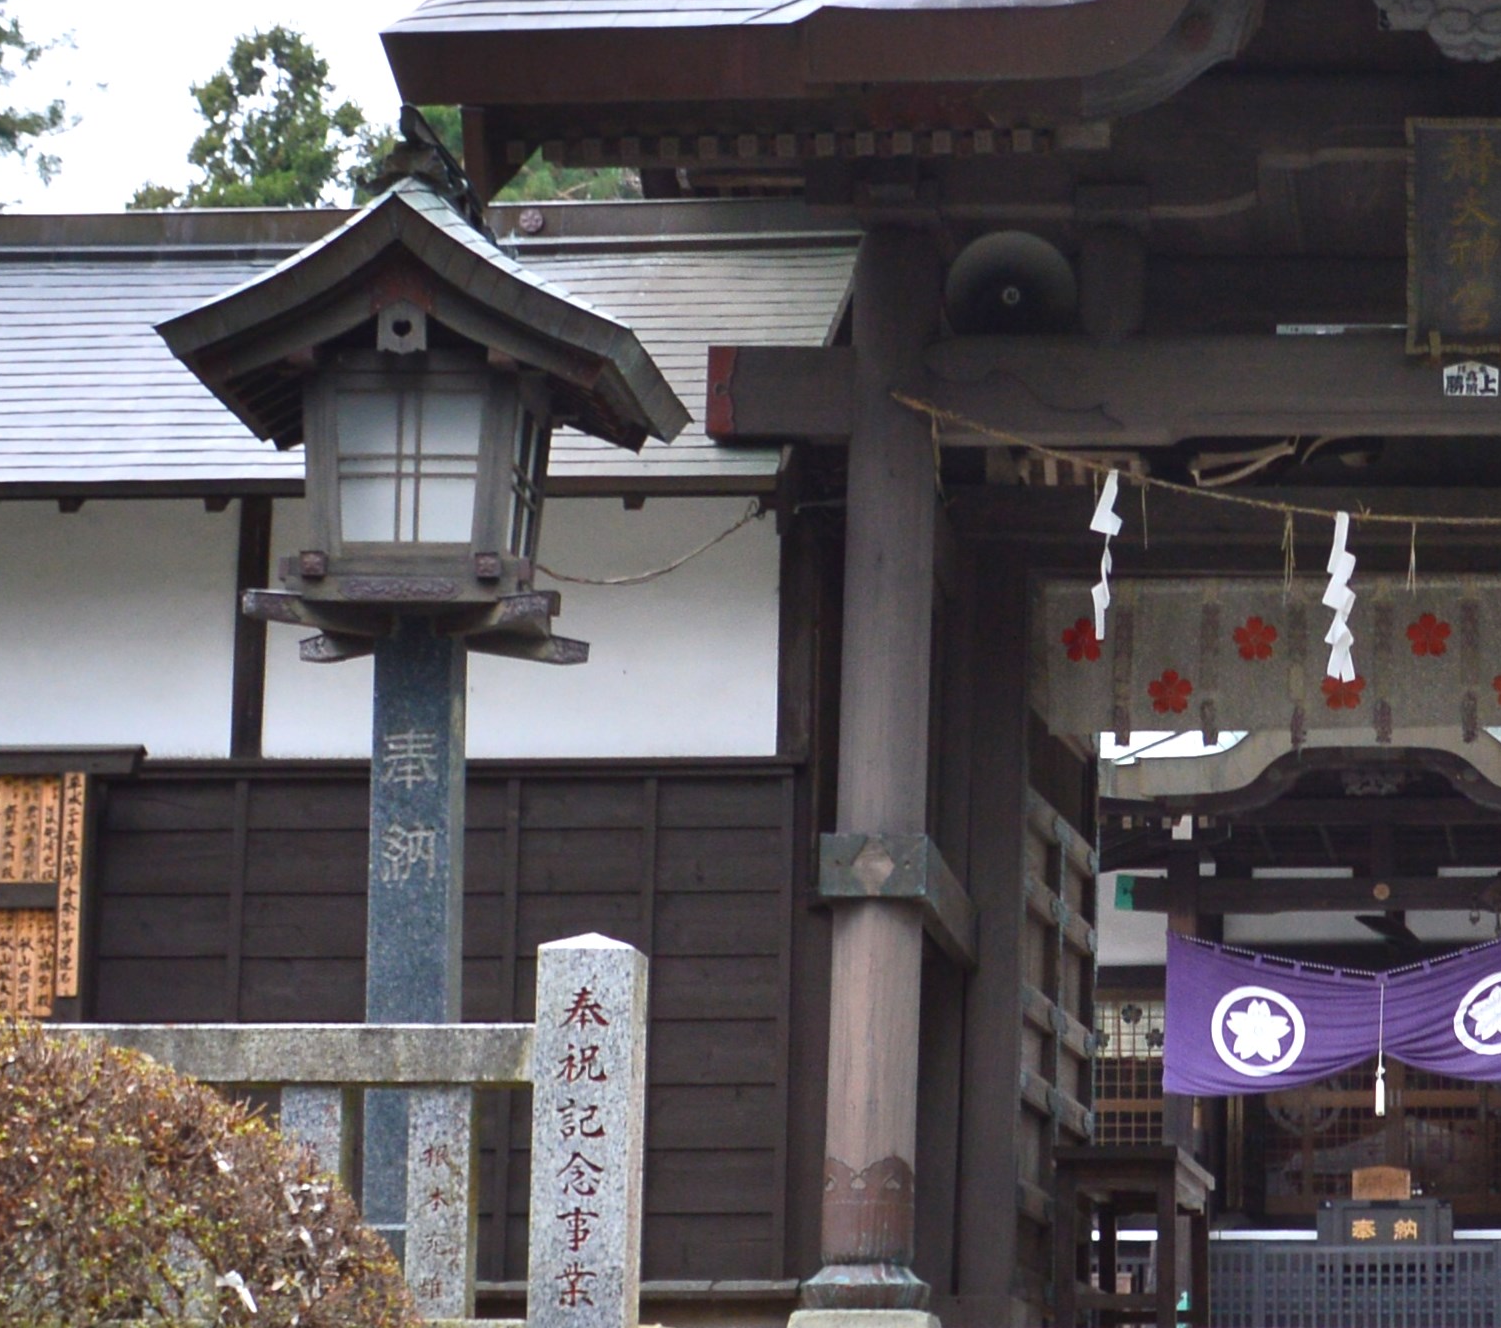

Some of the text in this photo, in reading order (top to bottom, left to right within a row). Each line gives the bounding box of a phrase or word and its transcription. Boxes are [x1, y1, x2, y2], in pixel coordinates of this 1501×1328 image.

[379, 727, 440, 888] 奉納
[555, 986, 610, 1308] 奉祝記念事業
[1351, 1218, 1418, 1241] 奉納
